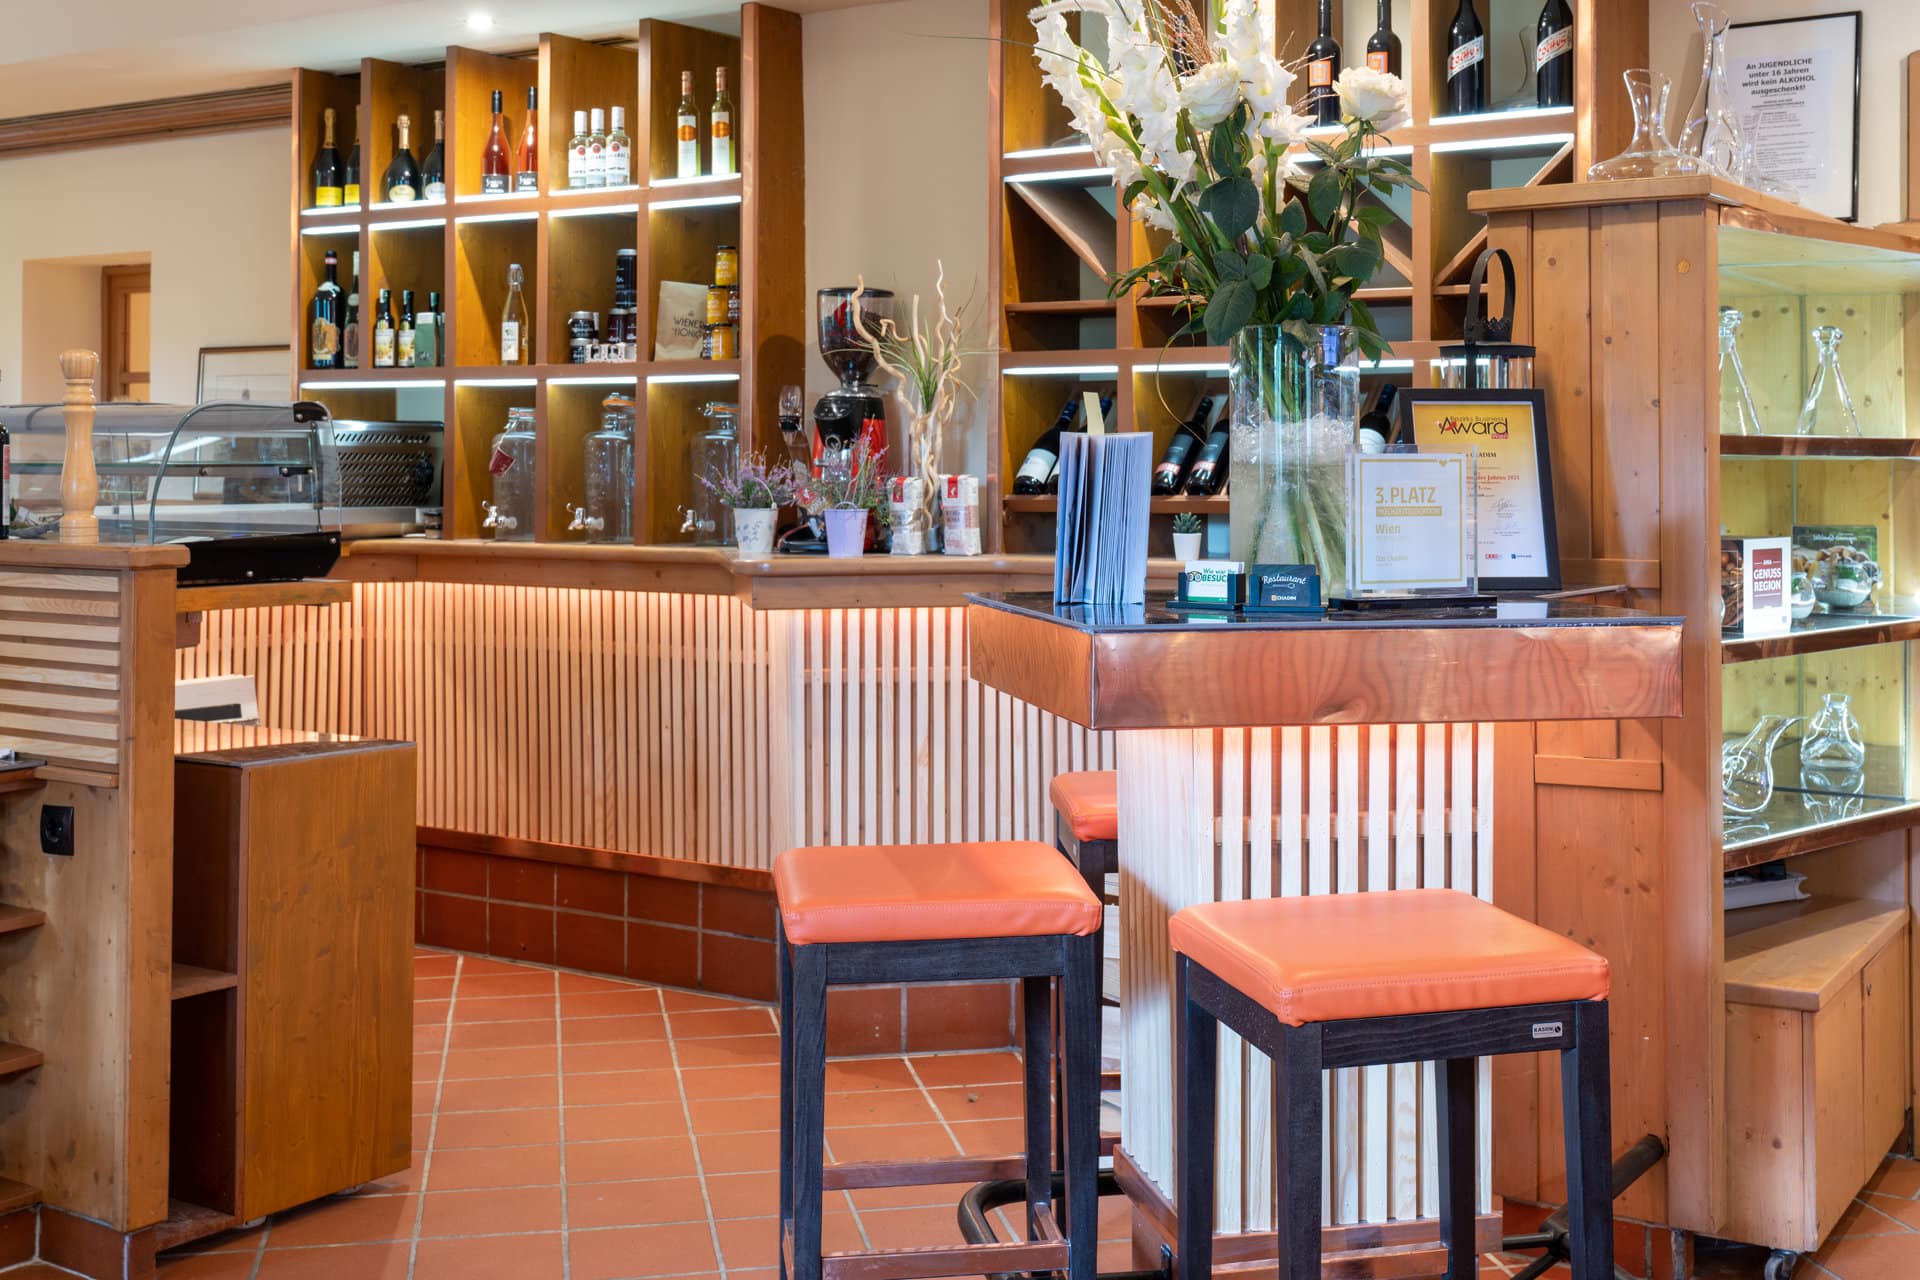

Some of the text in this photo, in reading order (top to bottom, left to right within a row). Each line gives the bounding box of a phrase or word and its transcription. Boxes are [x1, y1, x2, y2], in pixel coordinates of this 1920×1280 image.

[1758, 58, 1813, 69] JUGENDLICHE
[1749, 71, 1769, 79] unter
[1784, 67, 1809, 75] Jahren
[1761, 78, 1777, 86] kein
[1779, 75, 1815, 84] ALKOHOL
[1440, 416, 1508, 435] Award
[1375, 523, 1401, 534] Wien
[1201, 574, 1228, 583] BESUC
[1262, 572, 1307, 585] Restaurant
[1753, 567, 1782, 580] GENUSS
[1753, 579, 1782, 592] REGION
